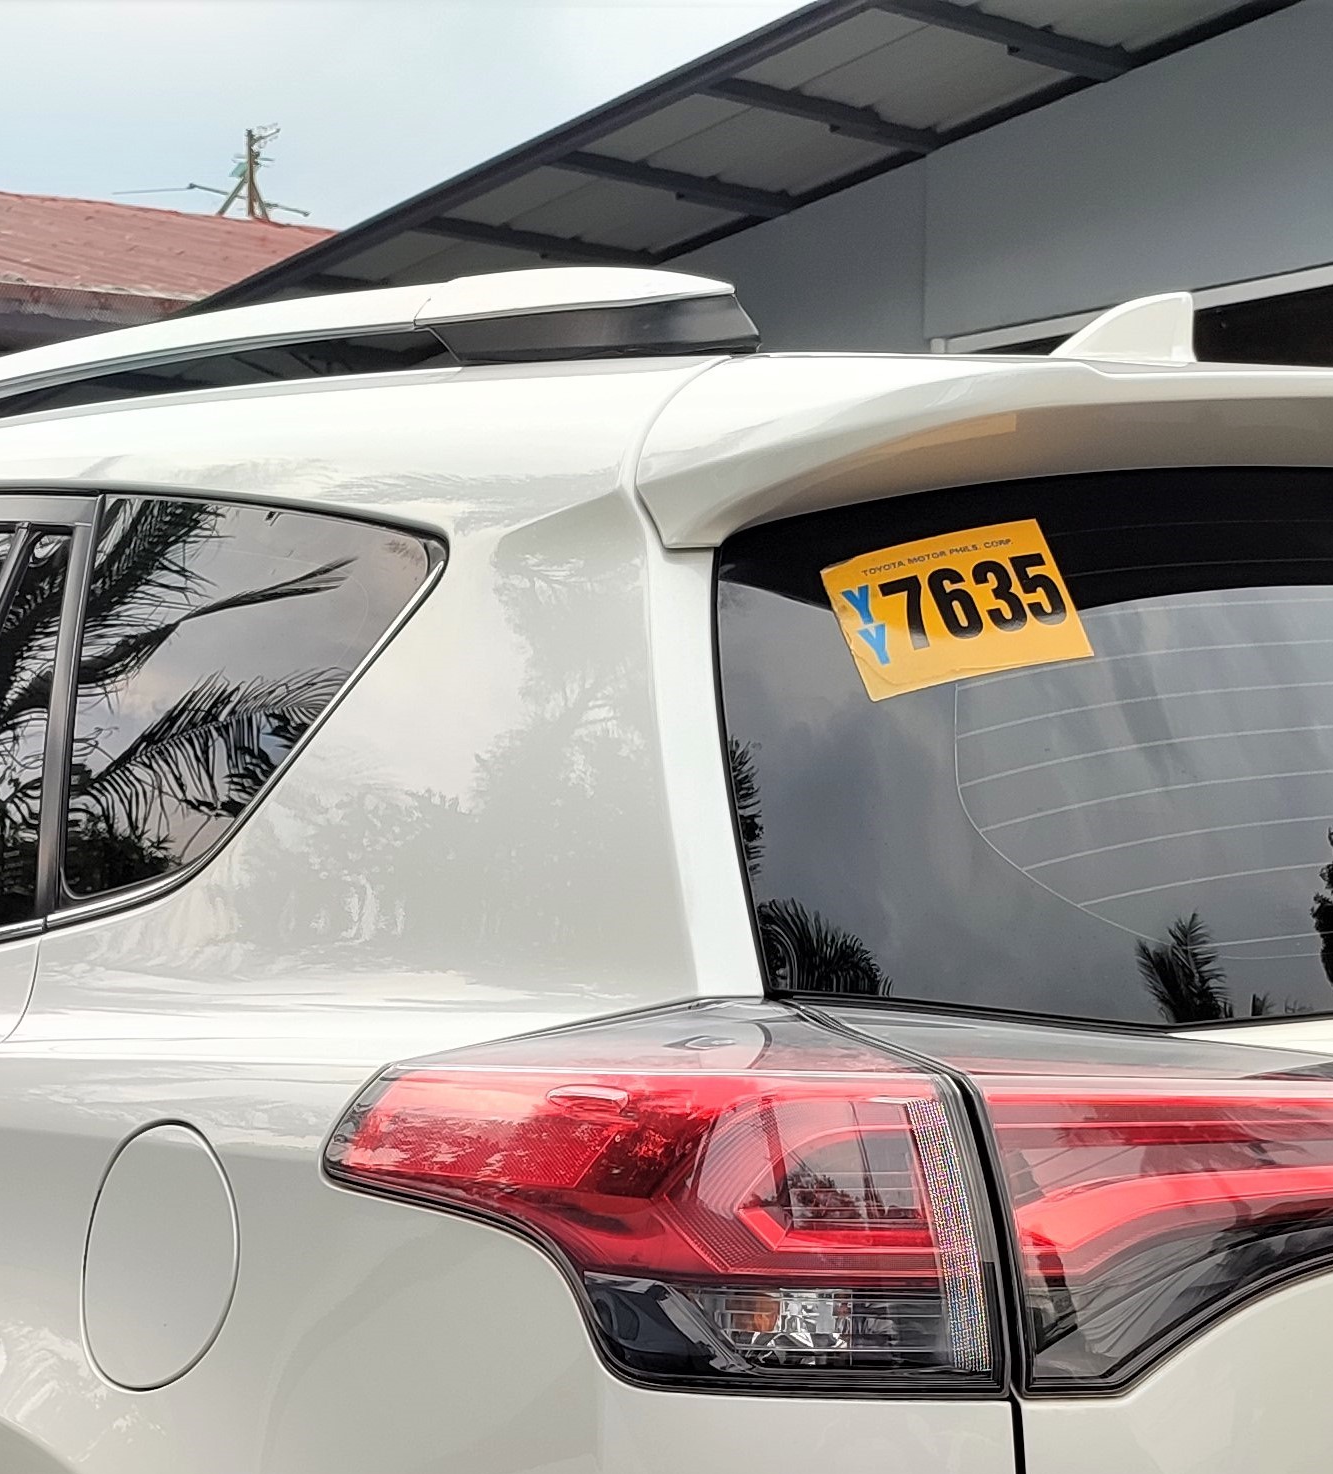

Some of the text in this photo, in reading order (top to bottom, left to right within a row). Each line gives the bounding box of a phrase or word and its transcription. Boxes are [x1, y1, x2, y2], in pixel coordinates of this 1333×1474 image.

[907, 551, 948, 566] MOTOR
[840, 584, 874, 625] Y
[877, 552, 1068, 651] 7635
[858, 623, 891, 667] Y
